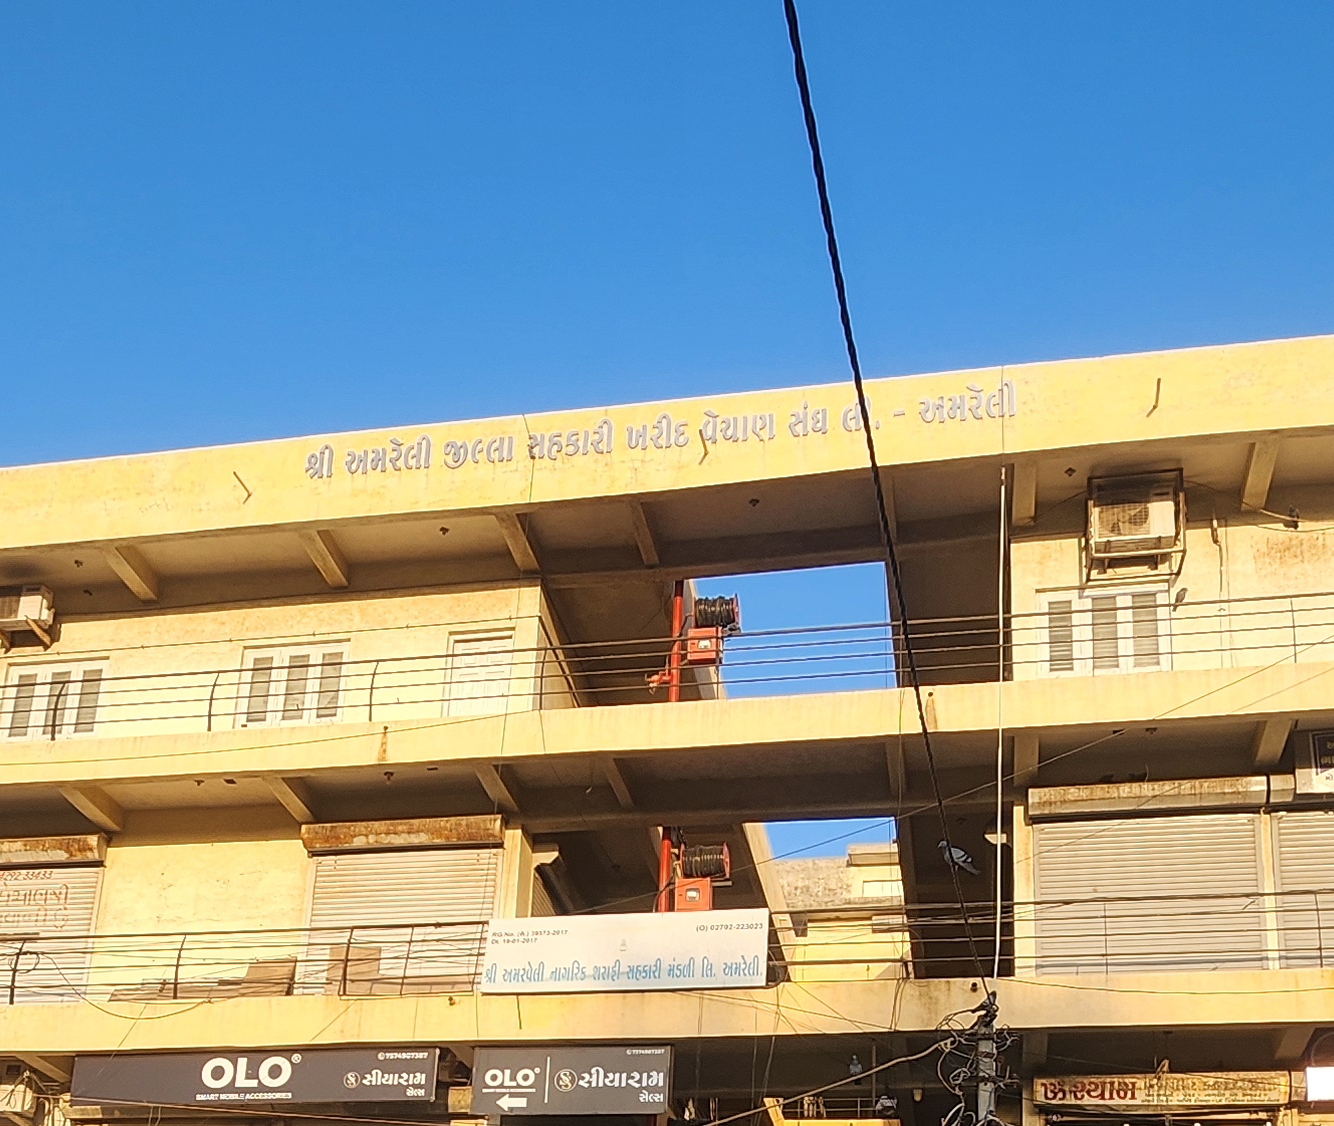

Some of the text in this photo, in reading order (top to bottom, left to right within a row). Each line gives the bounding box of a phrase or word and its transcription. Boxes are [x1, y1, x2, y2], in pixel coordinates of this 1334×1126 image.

[305, 444, 334, 479] શ્રી
[345, 434, 432, 475] અમરેલી
[443, 435, 515, 469] જીલ્લા
[528, 418, 614, 462] સહકારી
[626, 412, 689, 449] ખરીદ
[701, 410, 775, 444] વેચાણ
[788, 401, 829, 437] સંઘ
[919, 380, 1017, 424] અમરેલી
[484, 962, 498, 984] શ્રી
[550, 960, 587, 982] નાગરિક
[626, 958, 661, 980] સહકારી
[668, 956, 695, 980] મંડળી
[202, 1056, 292, 1089] OLO
[362, 1069, 426, 1086] સીયારામ
[485, 1069, 535, 1087] OLO
[578, 1066, 664, 1088] સીયારામ
[639, 1090, 664, 1103] સેલ્સ
